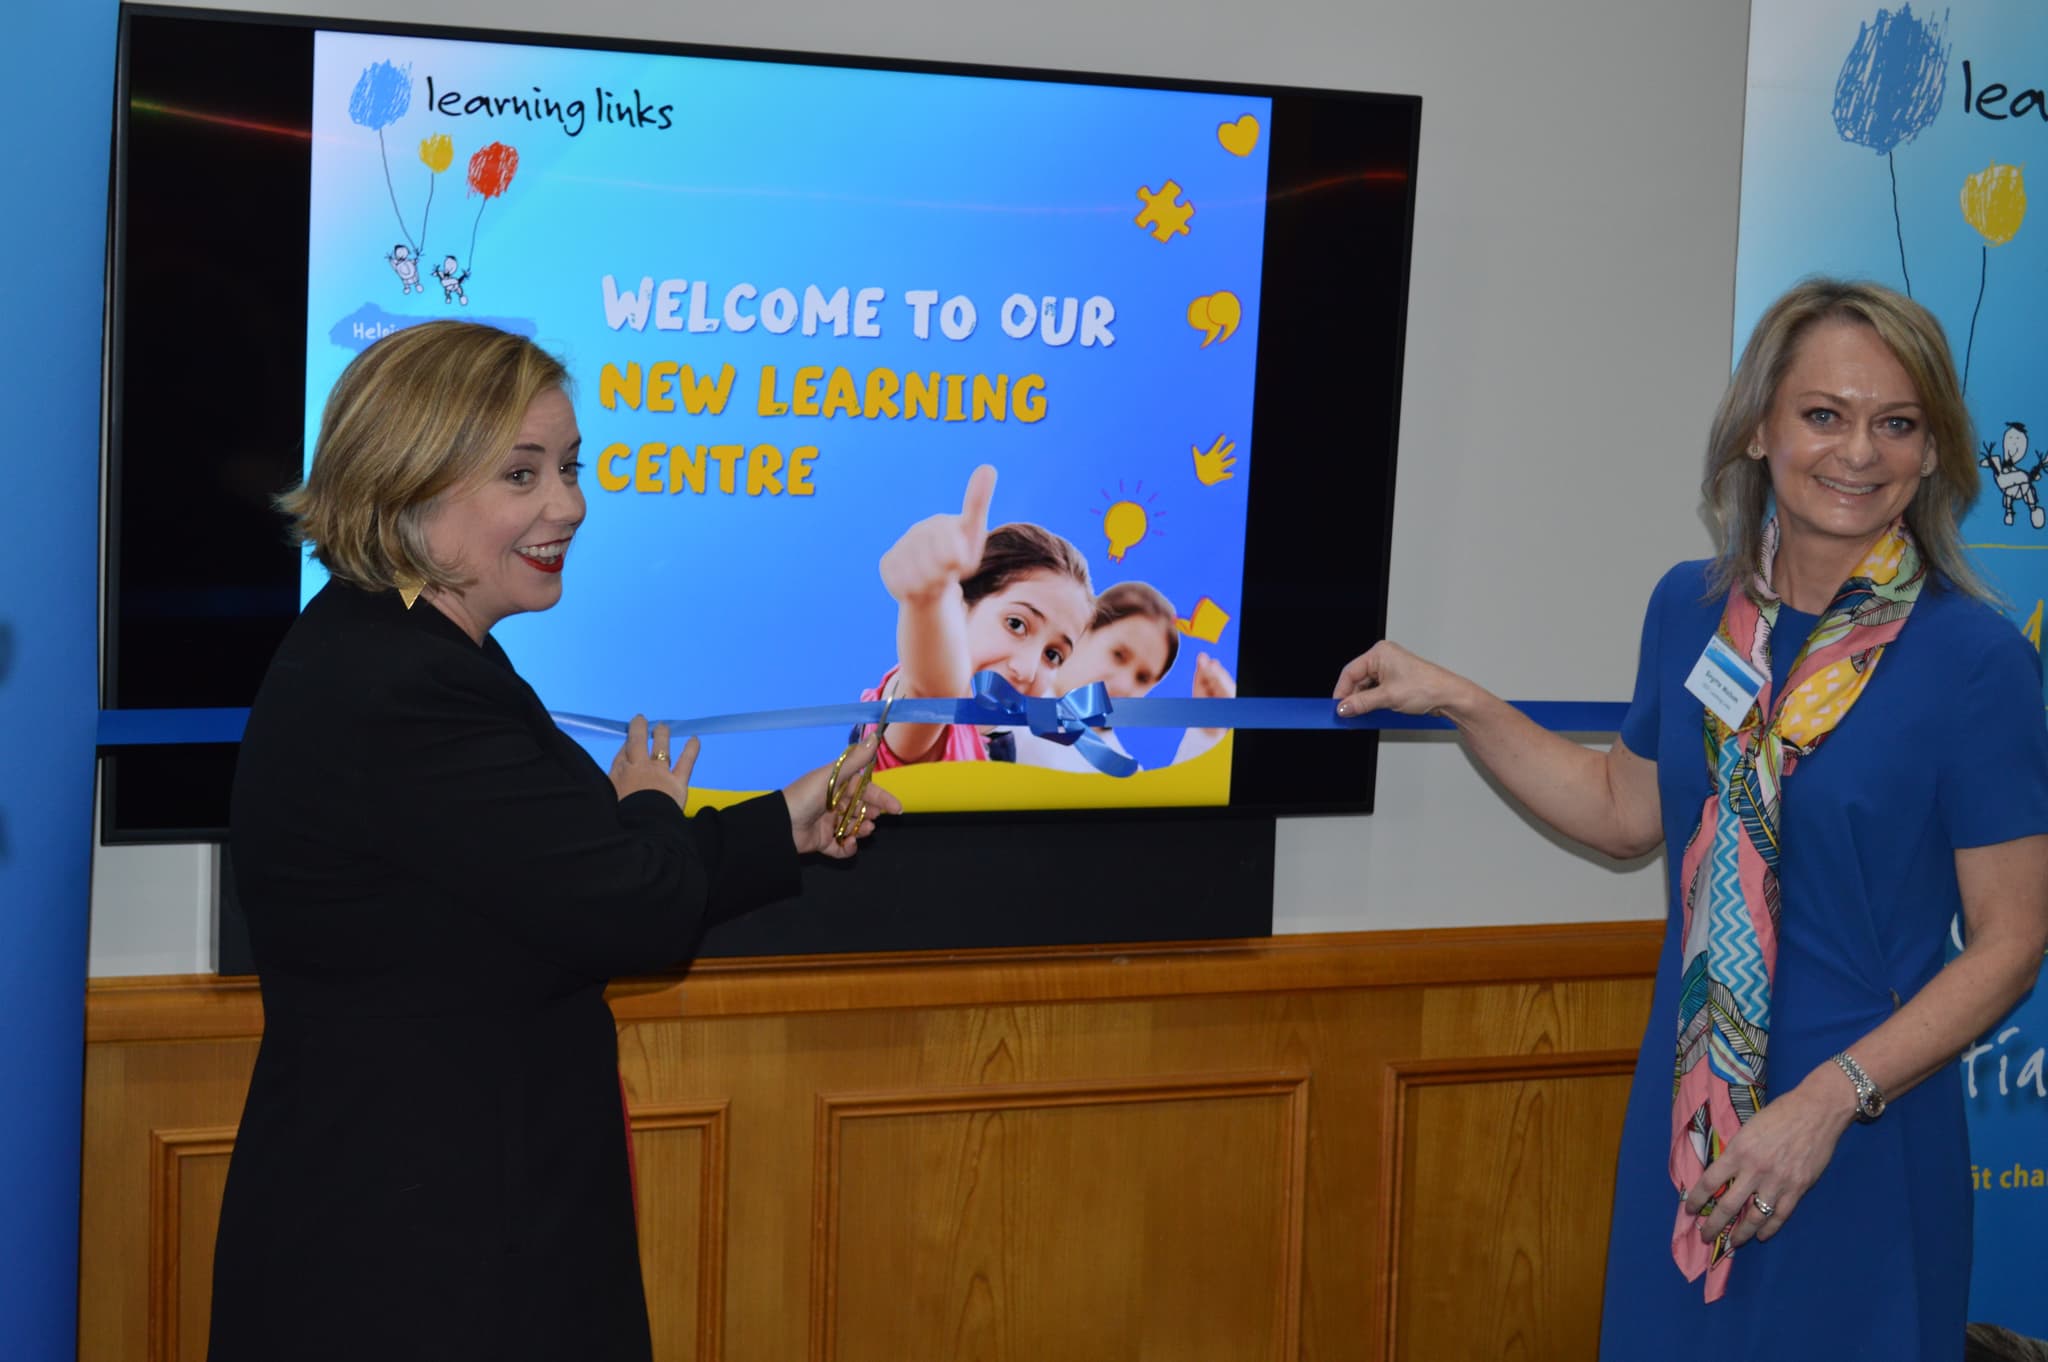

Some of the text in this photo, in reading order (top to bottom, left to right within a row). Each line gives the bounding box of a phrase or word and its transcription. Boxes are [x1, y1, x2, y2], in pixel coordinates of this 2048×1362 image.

[426, 75, 674, 137] learning links
[602, 274, 1117, 347] WELCOME TO OUR
[599, 360, 1048, 423] NEW LEARNING
[596, 442, 820, 497] CENTRE
[1999, 1163, 2048, 1189] cha
